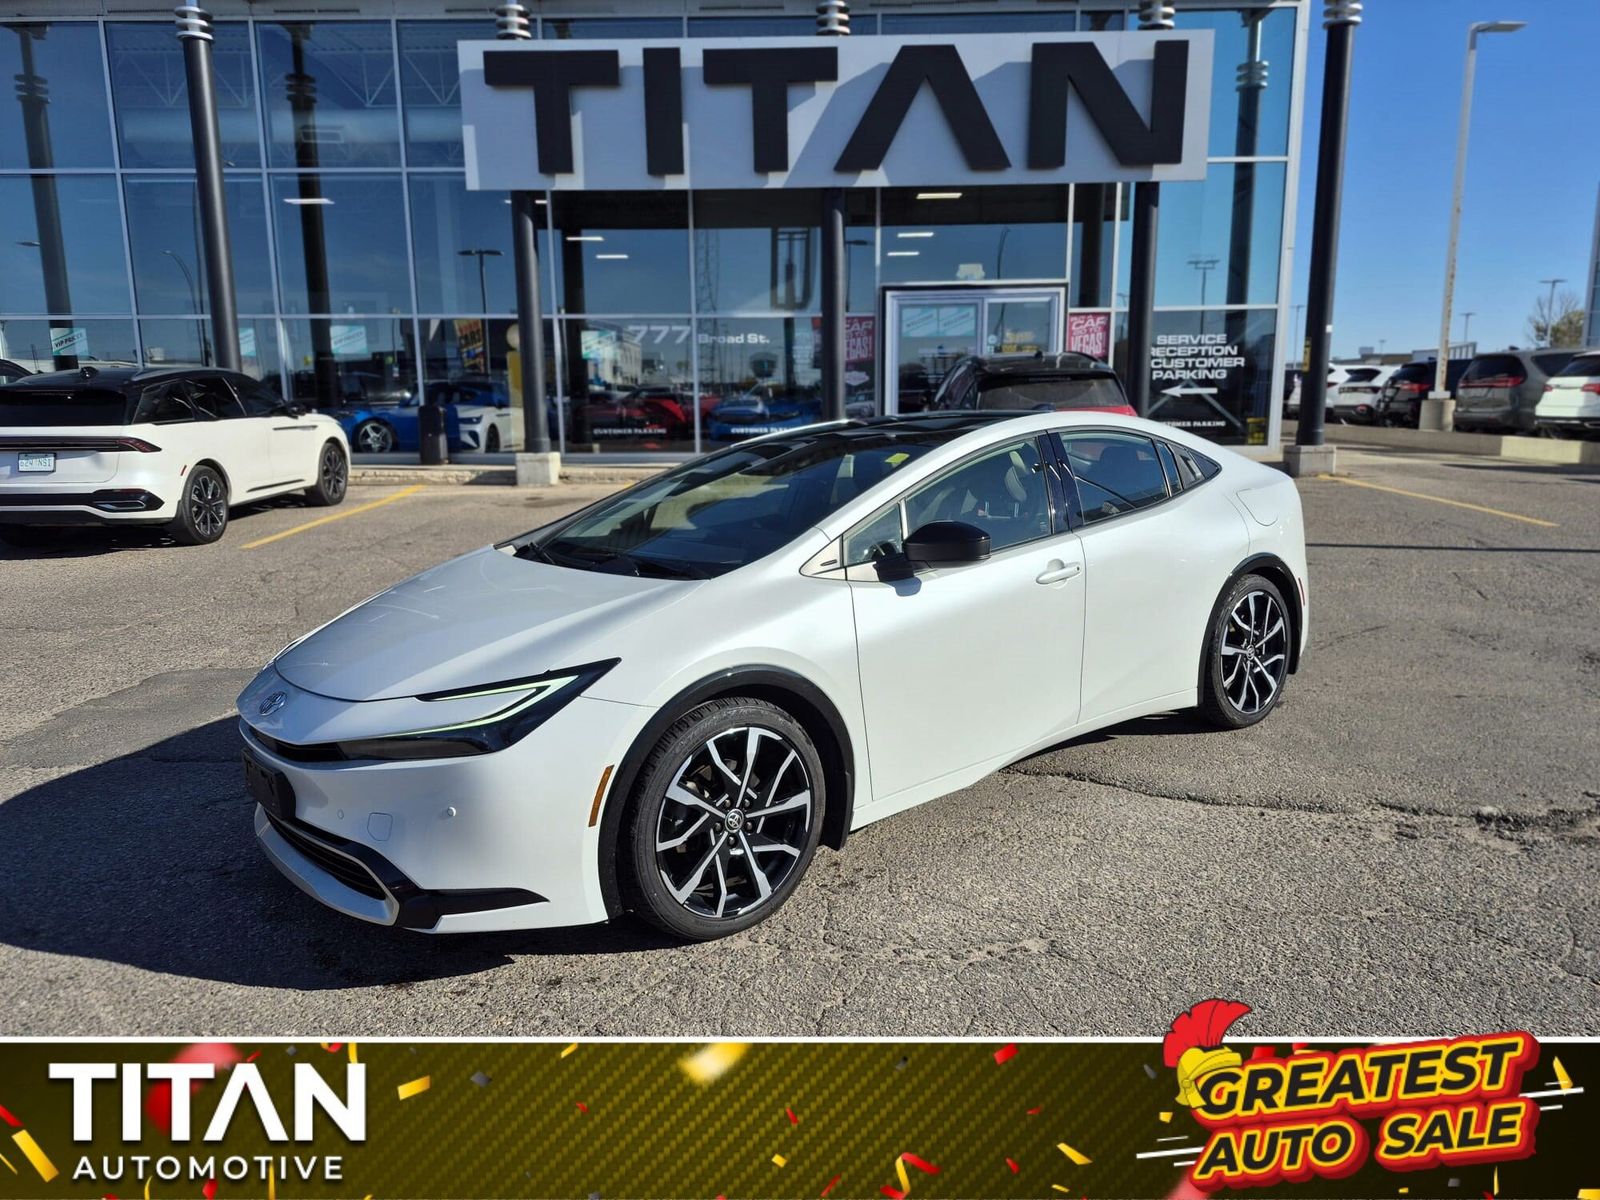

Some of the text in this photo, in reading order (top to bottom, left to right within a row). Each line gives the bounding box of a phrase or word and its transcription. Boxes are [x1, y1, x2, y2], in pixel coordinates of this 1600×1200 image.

[484, 40, 1189, 175] TITAN
[628, 325, 691, 344] 777
[698, 333, 770, 344] Broad St.
[1157, 334, 1227, 345] SERVICE
[1151, 357, 1245, 368] CUSTOMER
[1152, 369, 1227, 380] PARKING
